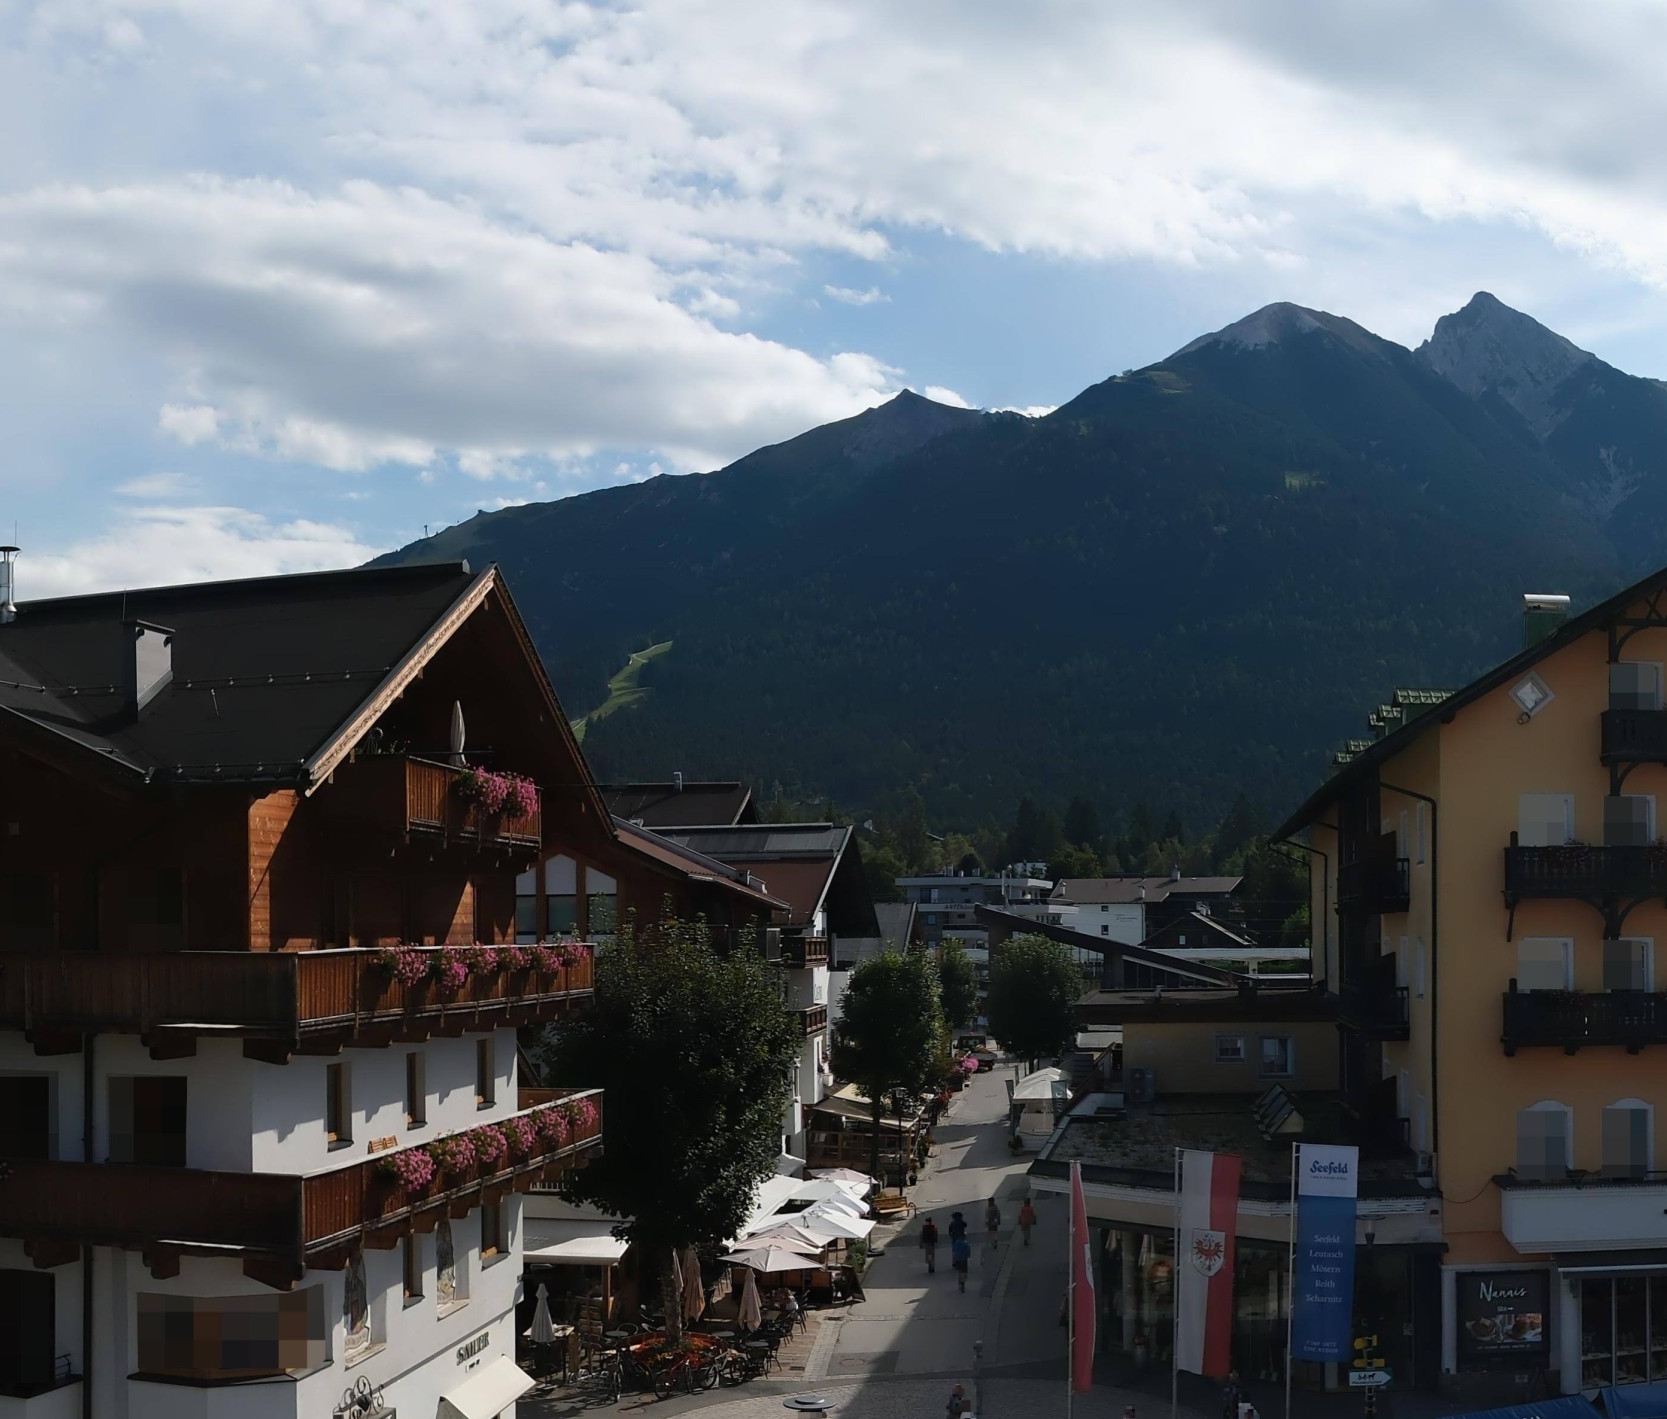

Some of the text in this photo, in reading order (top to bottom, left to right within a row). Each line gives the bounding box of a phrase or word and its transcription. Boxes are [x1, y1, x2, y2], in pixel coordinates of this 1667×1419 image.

[1310, 1160, 1348, 1175] Seefeld
[1314, 1234, 1340, 1244] Seefeld
[1309, 1249, 1343, 1260] Leutasch
[1311, 1264, 1341, 1274] Mösern
[1315, 1279, 1335, 1289] Reith
[1306, 1294, 1342, 1303] Scharnitz
